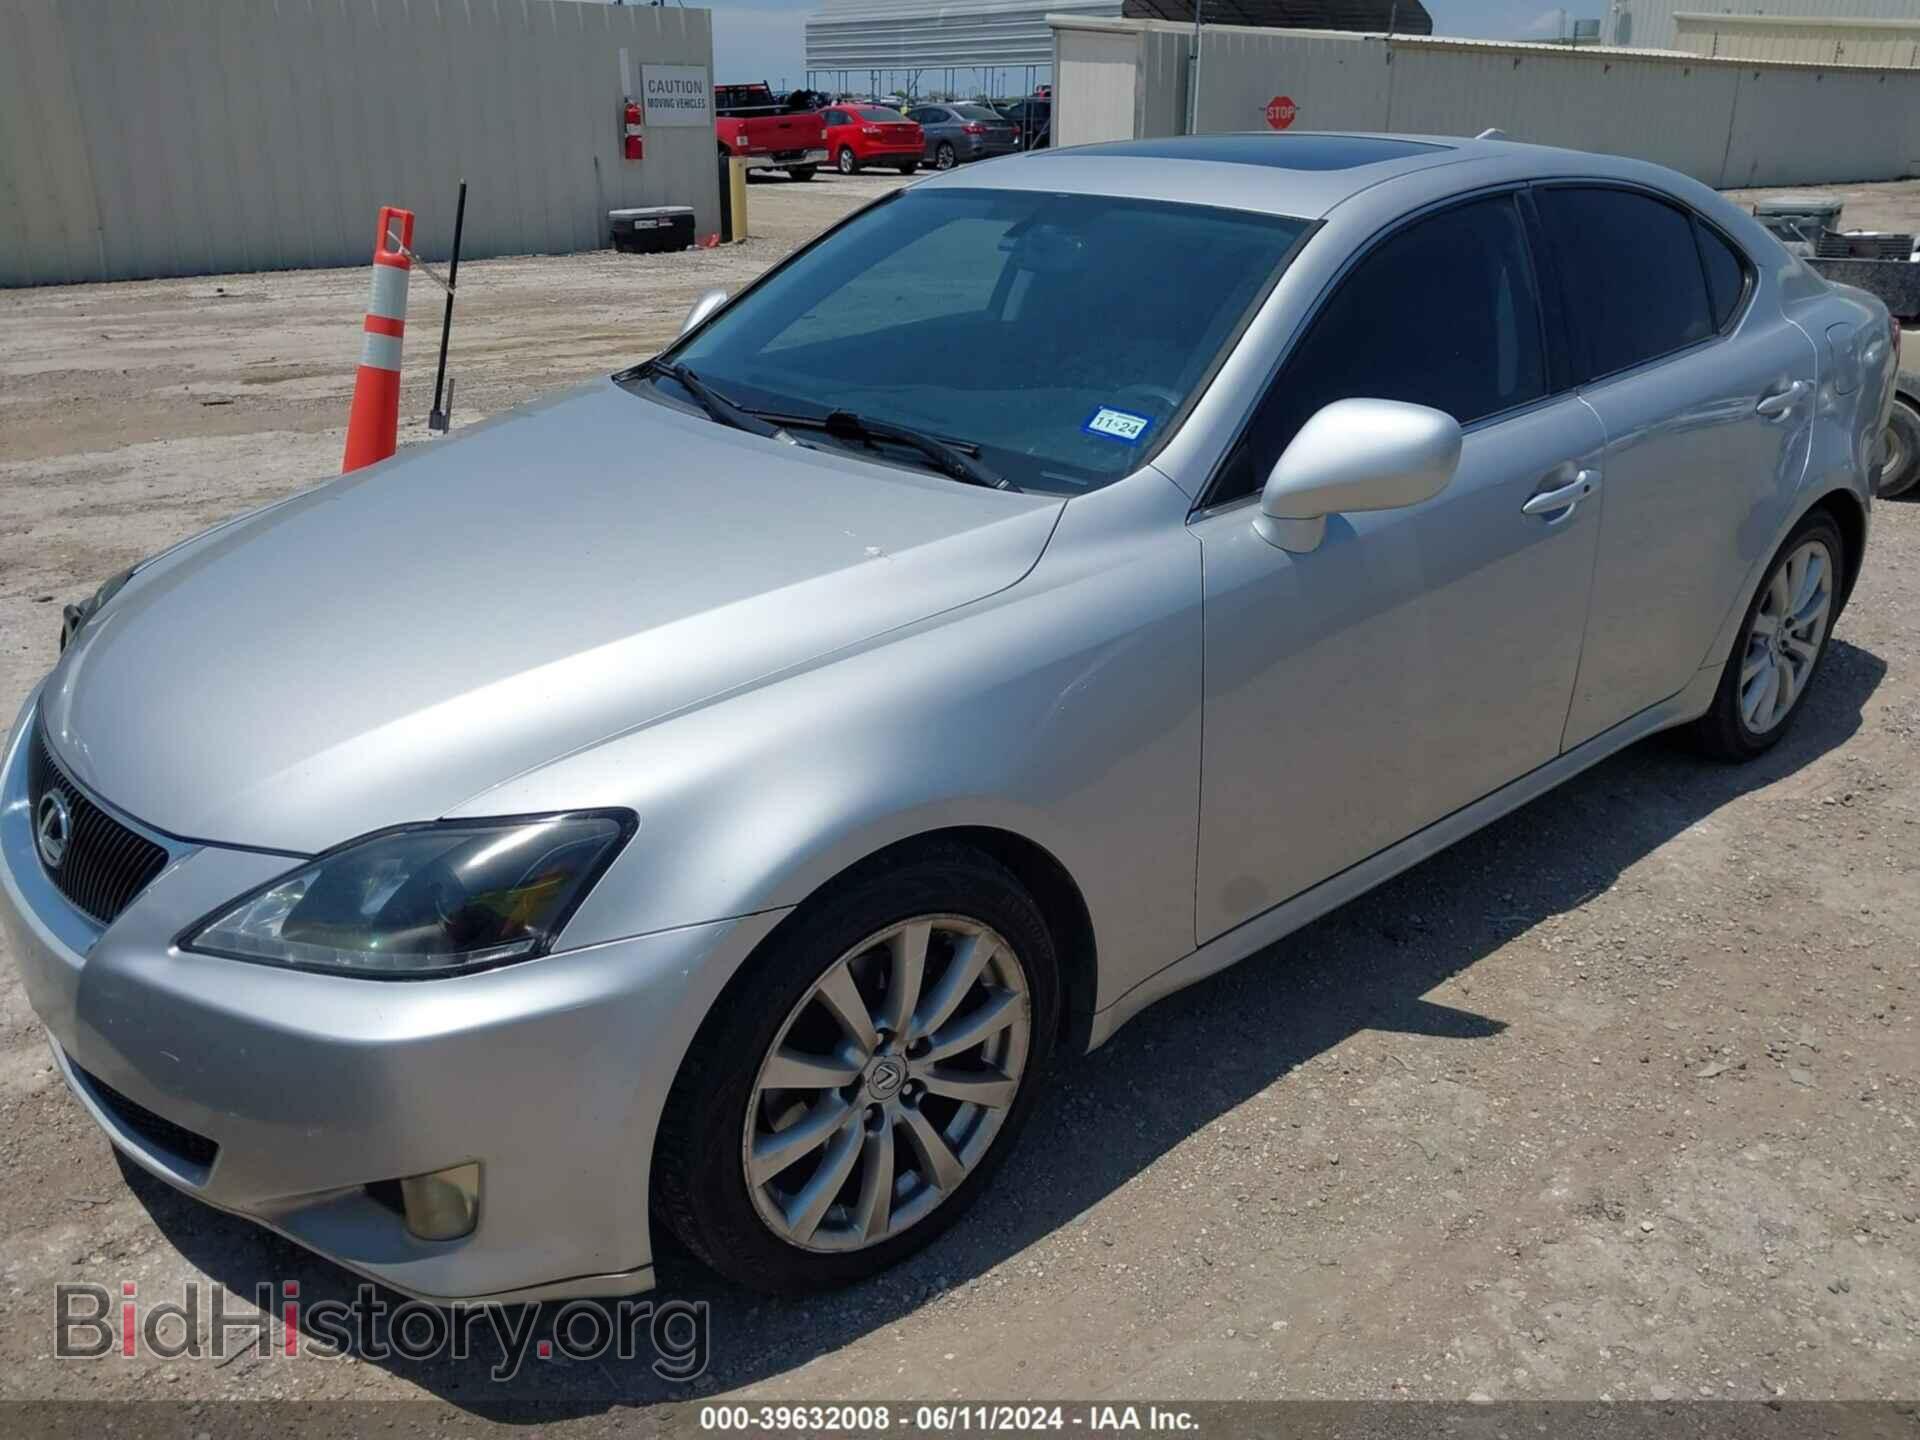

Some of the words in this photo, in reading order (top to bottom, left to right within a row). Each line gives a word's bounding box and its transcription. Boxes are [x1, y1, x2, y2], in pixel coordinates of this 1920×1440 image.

[648, 79, 703, 94] CAUTION
[647, 97, 676, 109] MOVING
[676, 98, 706, 109] VEHICLES
[1268, 106, 1295, 119] STOP
